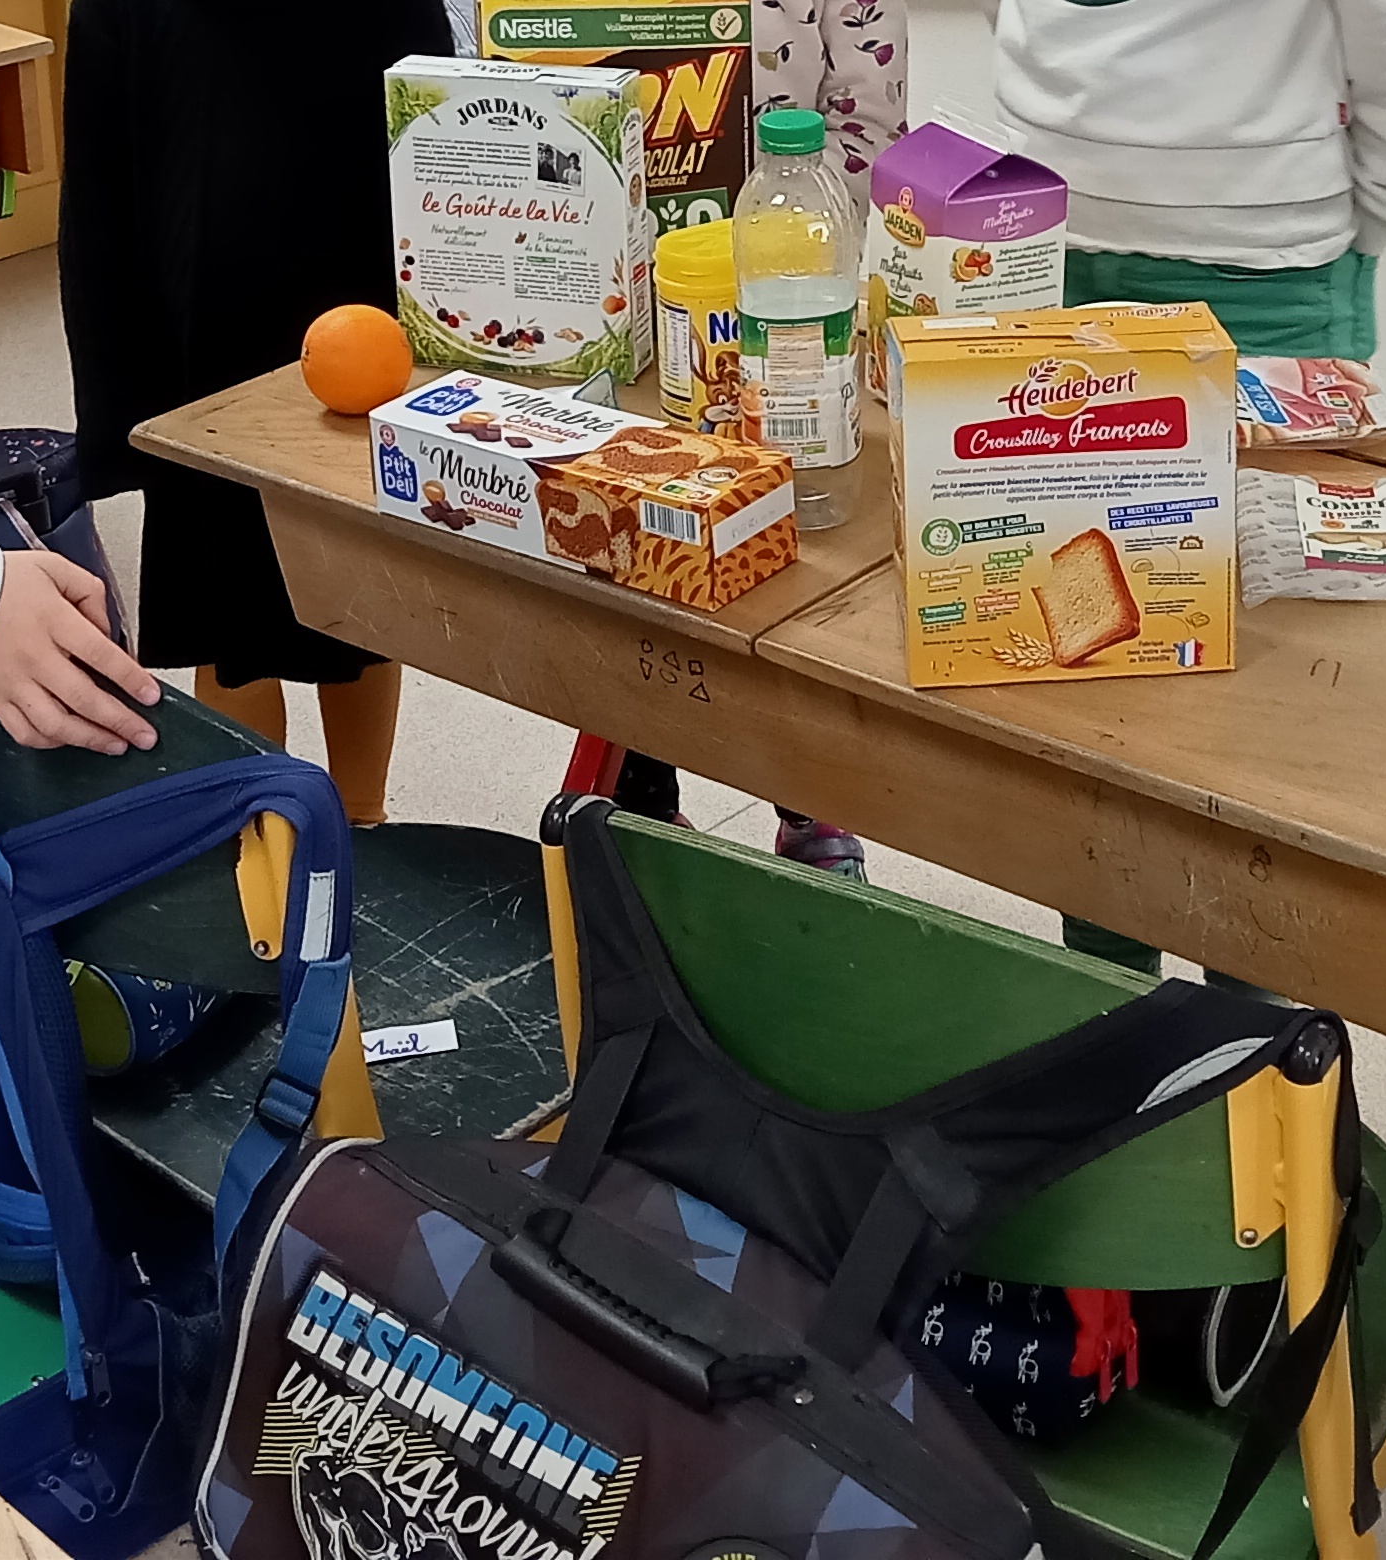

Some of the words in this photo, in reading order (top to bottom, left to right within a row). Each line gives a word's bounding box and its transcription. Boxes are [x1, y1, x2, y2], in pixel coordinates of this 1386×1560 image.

[498, 17, 573, 40] Nestlé
[456, 96, 549, 132] JORDANS
[421, 191, 442, 213] le
[445, 193, 497, 219] Goût
[498, 198, 523, 219] de
[525, 199, 549, 222] la
[551, 199, 581, 224] Vie
[885, 209, 923, 242] JAFADEN
[997, 367, 1141, 415] Heudebert
[500, 392, 624, 433] Marbré
[504, 414, 589, 441] Chocolat
[969, 425, 1064, 455] Croustillez
[1069, 412, 1174, 449] Français
[384, 471, 416, 498] Déli
[429, 446, 531, 504] Marbré
[459, 489, 525, 520] Chocolat
